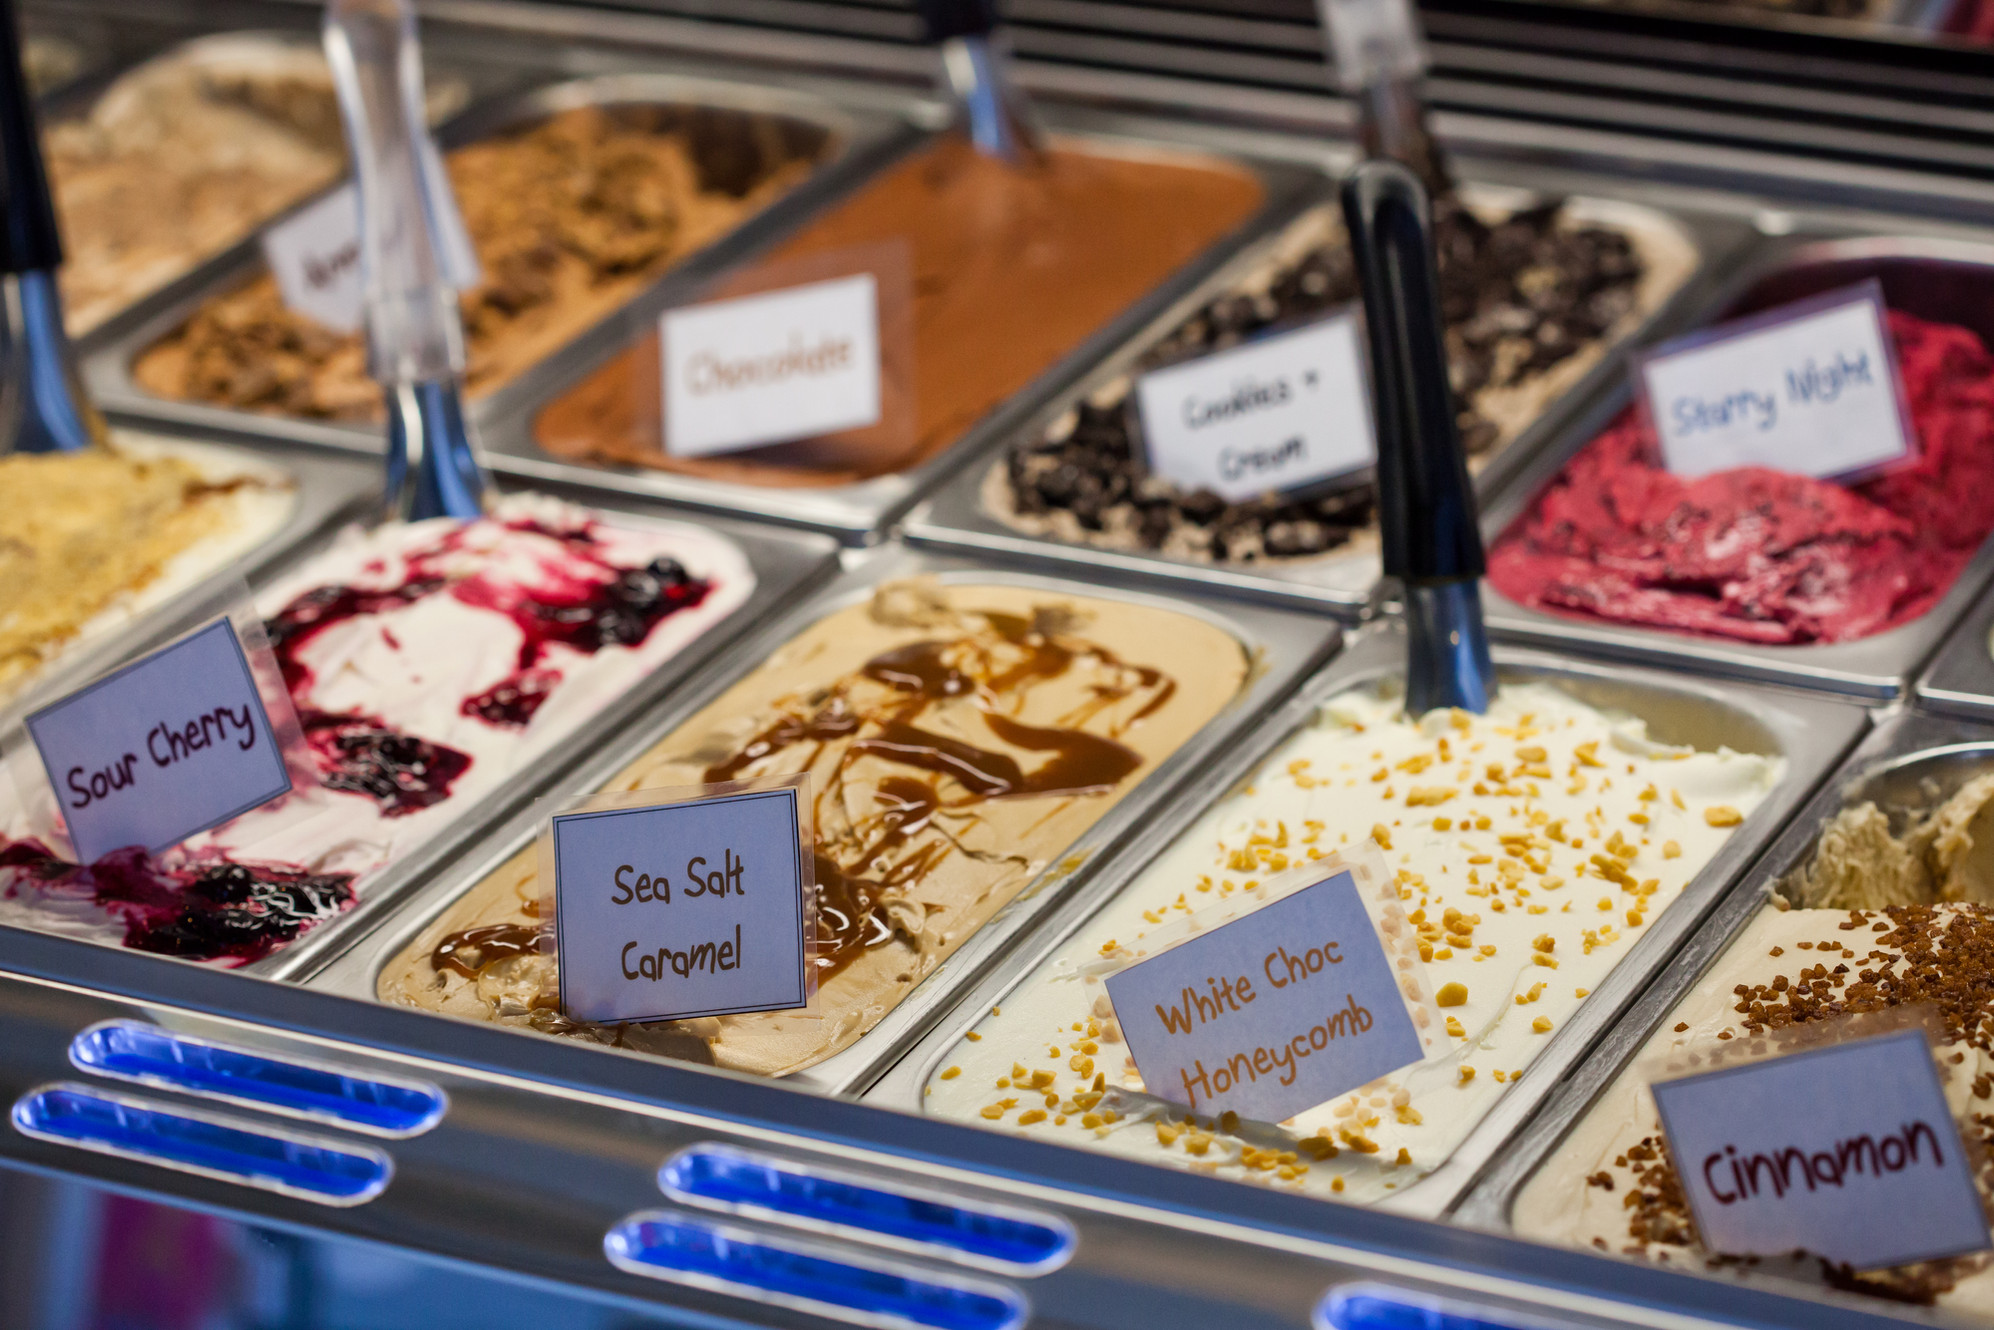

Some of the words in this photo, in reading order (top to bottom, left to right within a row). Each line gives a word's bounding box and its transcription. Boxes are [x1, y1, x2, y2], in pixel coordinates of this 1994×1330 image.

[1182, 376, 1292, 429] Cookies
[1673, 390, 1777, 437] Starry
[1785, 351, 1874, 403] Night
[1218, 435, 1307, 481] Cream
[67, 753, 138, 809] Sour
[147, 703, 256, 767] Cherry
[611, 864, 671, 905] Sea
[683, 848, 745, 898] Salt
[621, 924, 741, 982] Caramel
[1155, 977, 1256, 1035] White
[1264, 941, 1344, 988] Choc
[1181, 994, 1374, 1109] Honeycomb
[1703, 1120, 1945, 1206] Cinnamon
